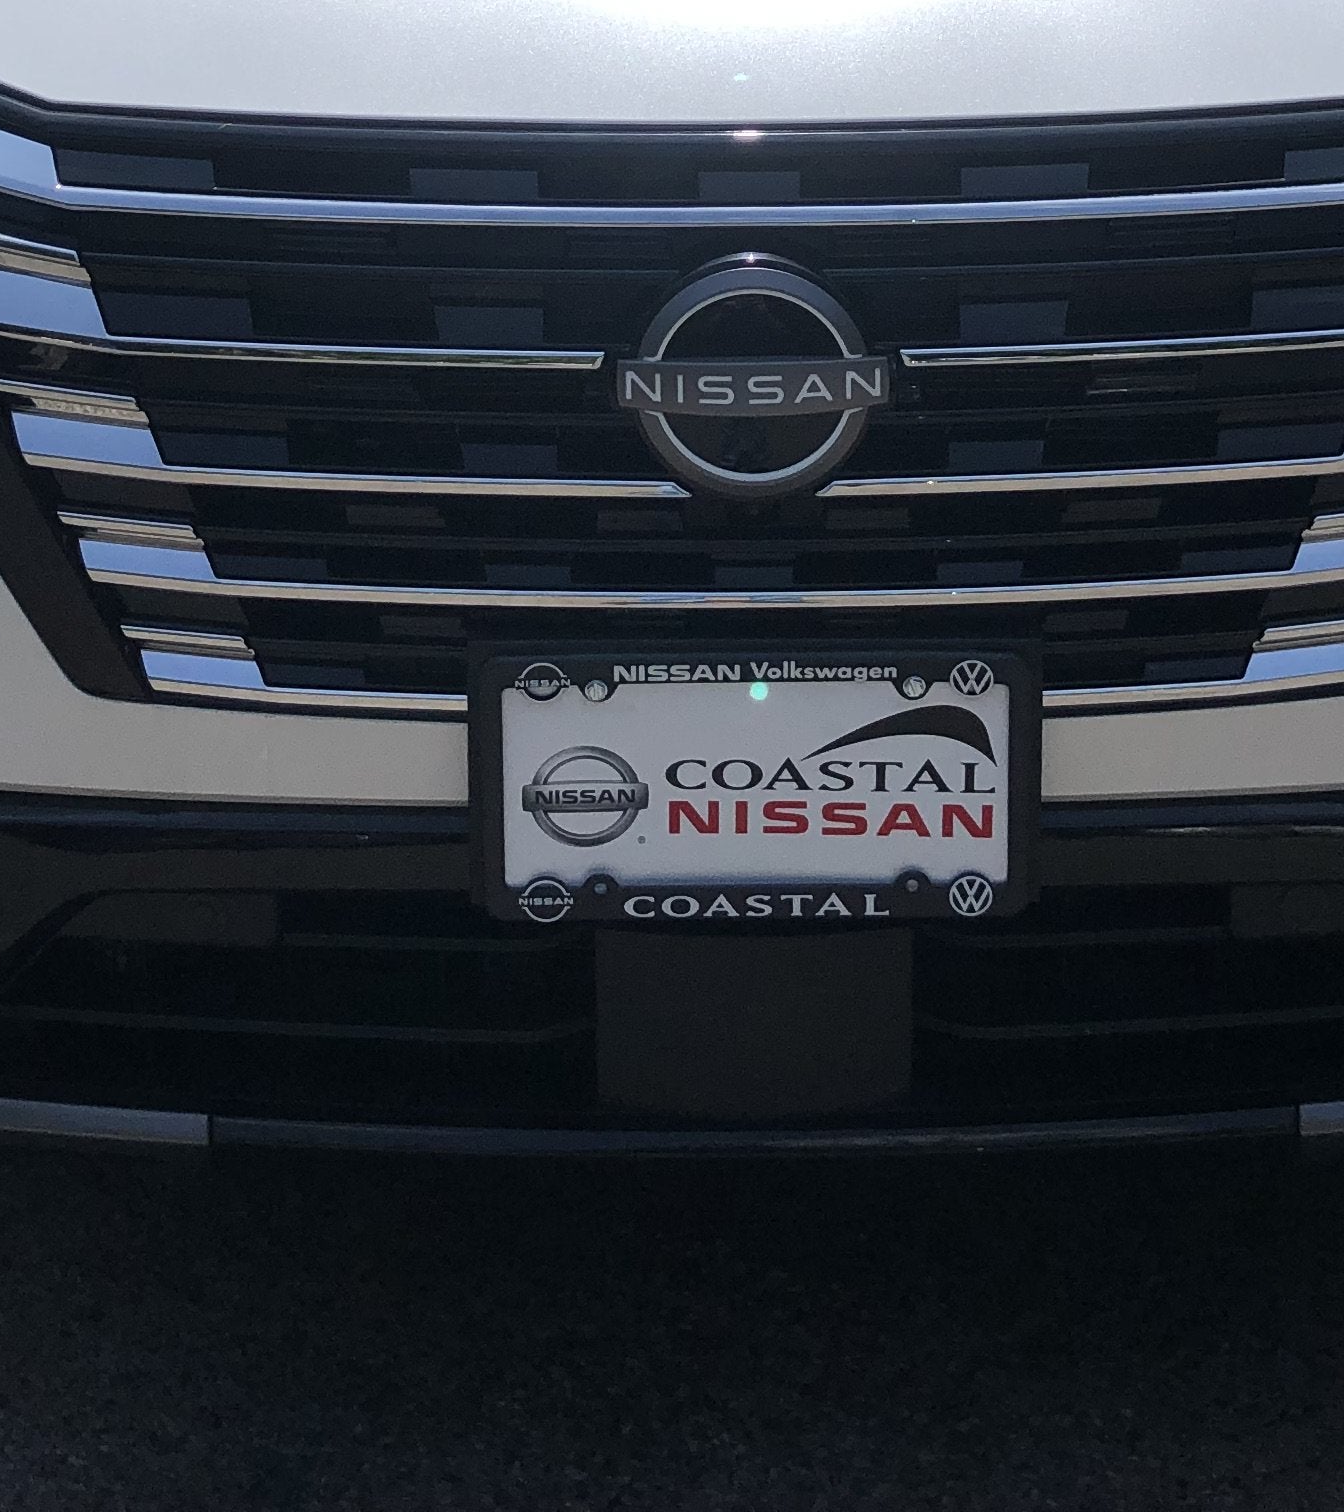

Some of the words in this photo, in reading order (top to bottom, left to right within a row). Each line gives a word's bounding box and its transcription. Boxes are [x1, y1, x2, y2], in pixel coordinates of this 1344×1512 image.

[624, 367, 882, 405] NISSAN
[514, 677, 571, 688] NISSAN
[613, 664, 741, 682] NISSAN
[750, 660, 898, 681] Volkswagen
[665, 757, 996, 794] COASTAL
[535, 789, 636, 805] NISSAN
[668, 800, 994, 839] NISSAN
[518, 896, 574, 906] NISSAN
[623, 892, 890, 918] COASTAL
